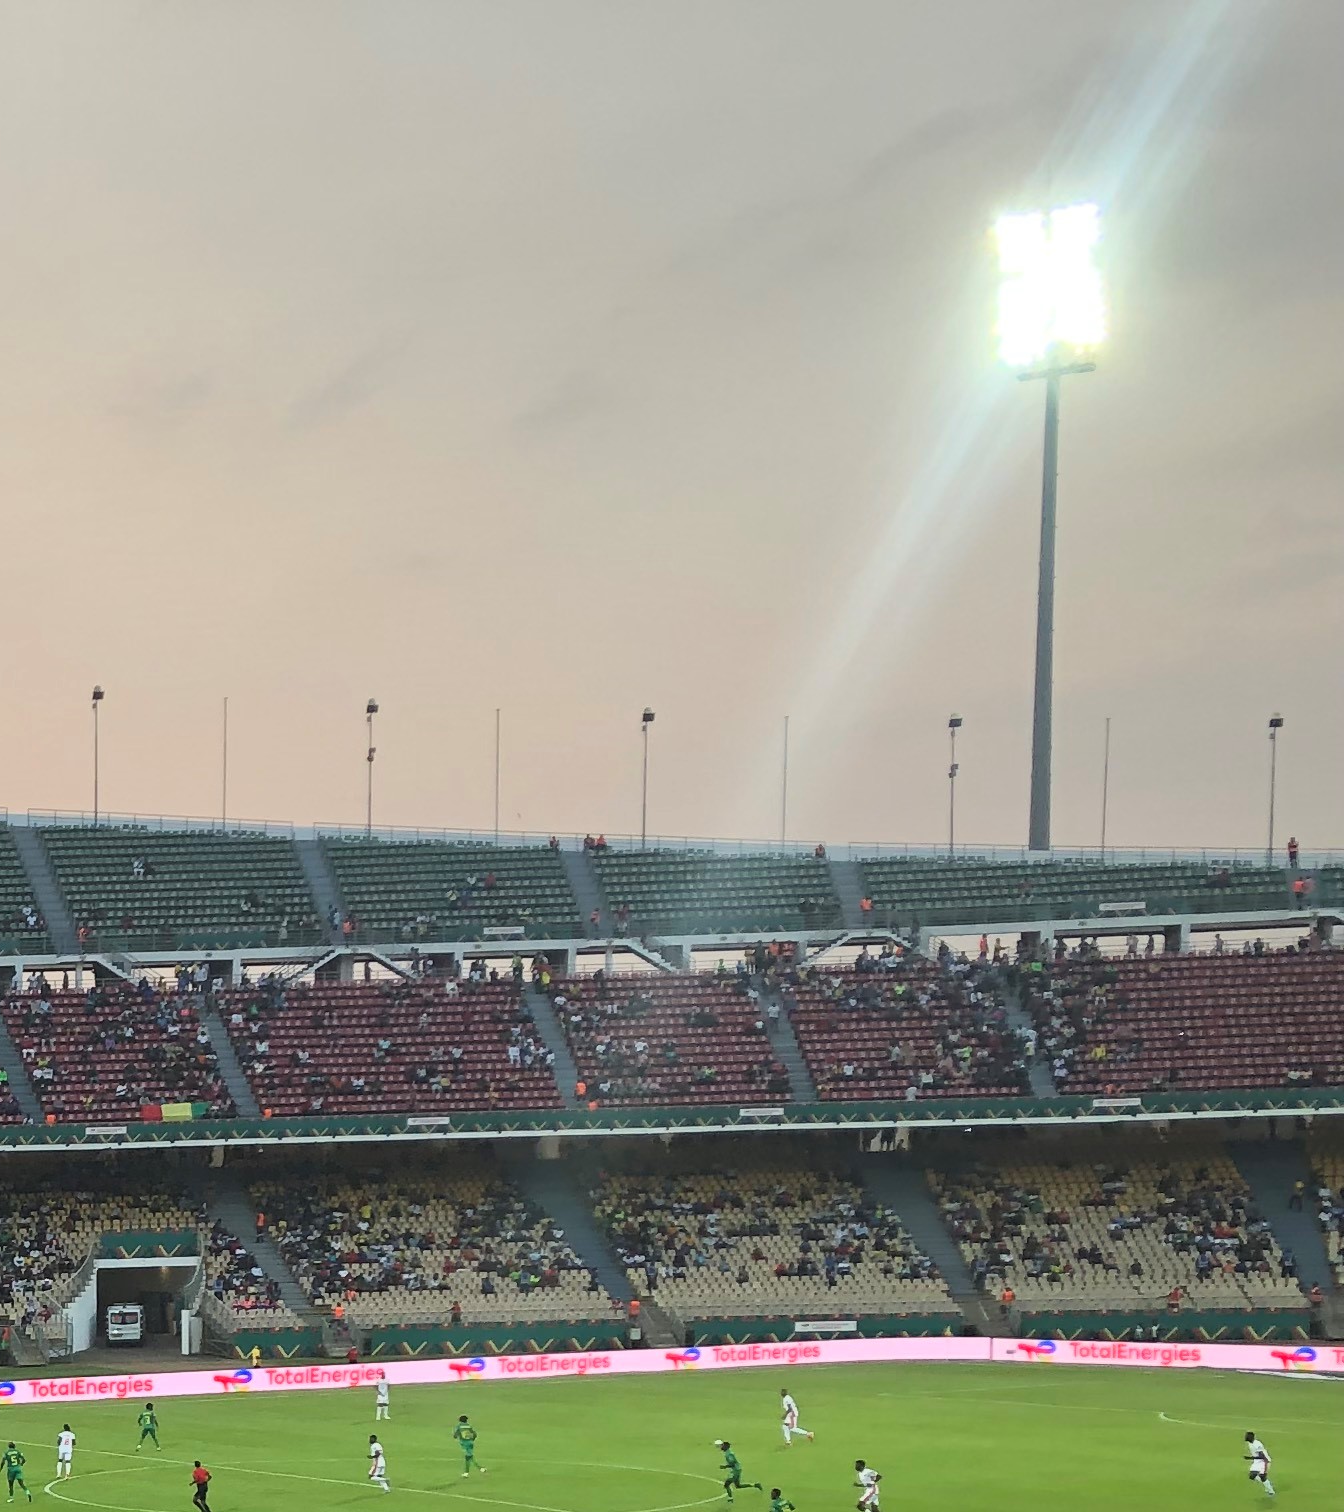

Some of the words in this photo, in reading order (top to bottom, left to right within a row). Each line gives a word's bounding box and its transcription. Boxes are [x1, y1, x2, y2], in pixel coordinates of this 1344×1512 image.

[713, 1343, 820, 1363] TotalEnergies
[1070, 1342, 1201, 1365] TotalEnergies
[499, 1354, 611, 1375] TotalEnergies
[29, 1376, 153, 1399] TotalEnergies
